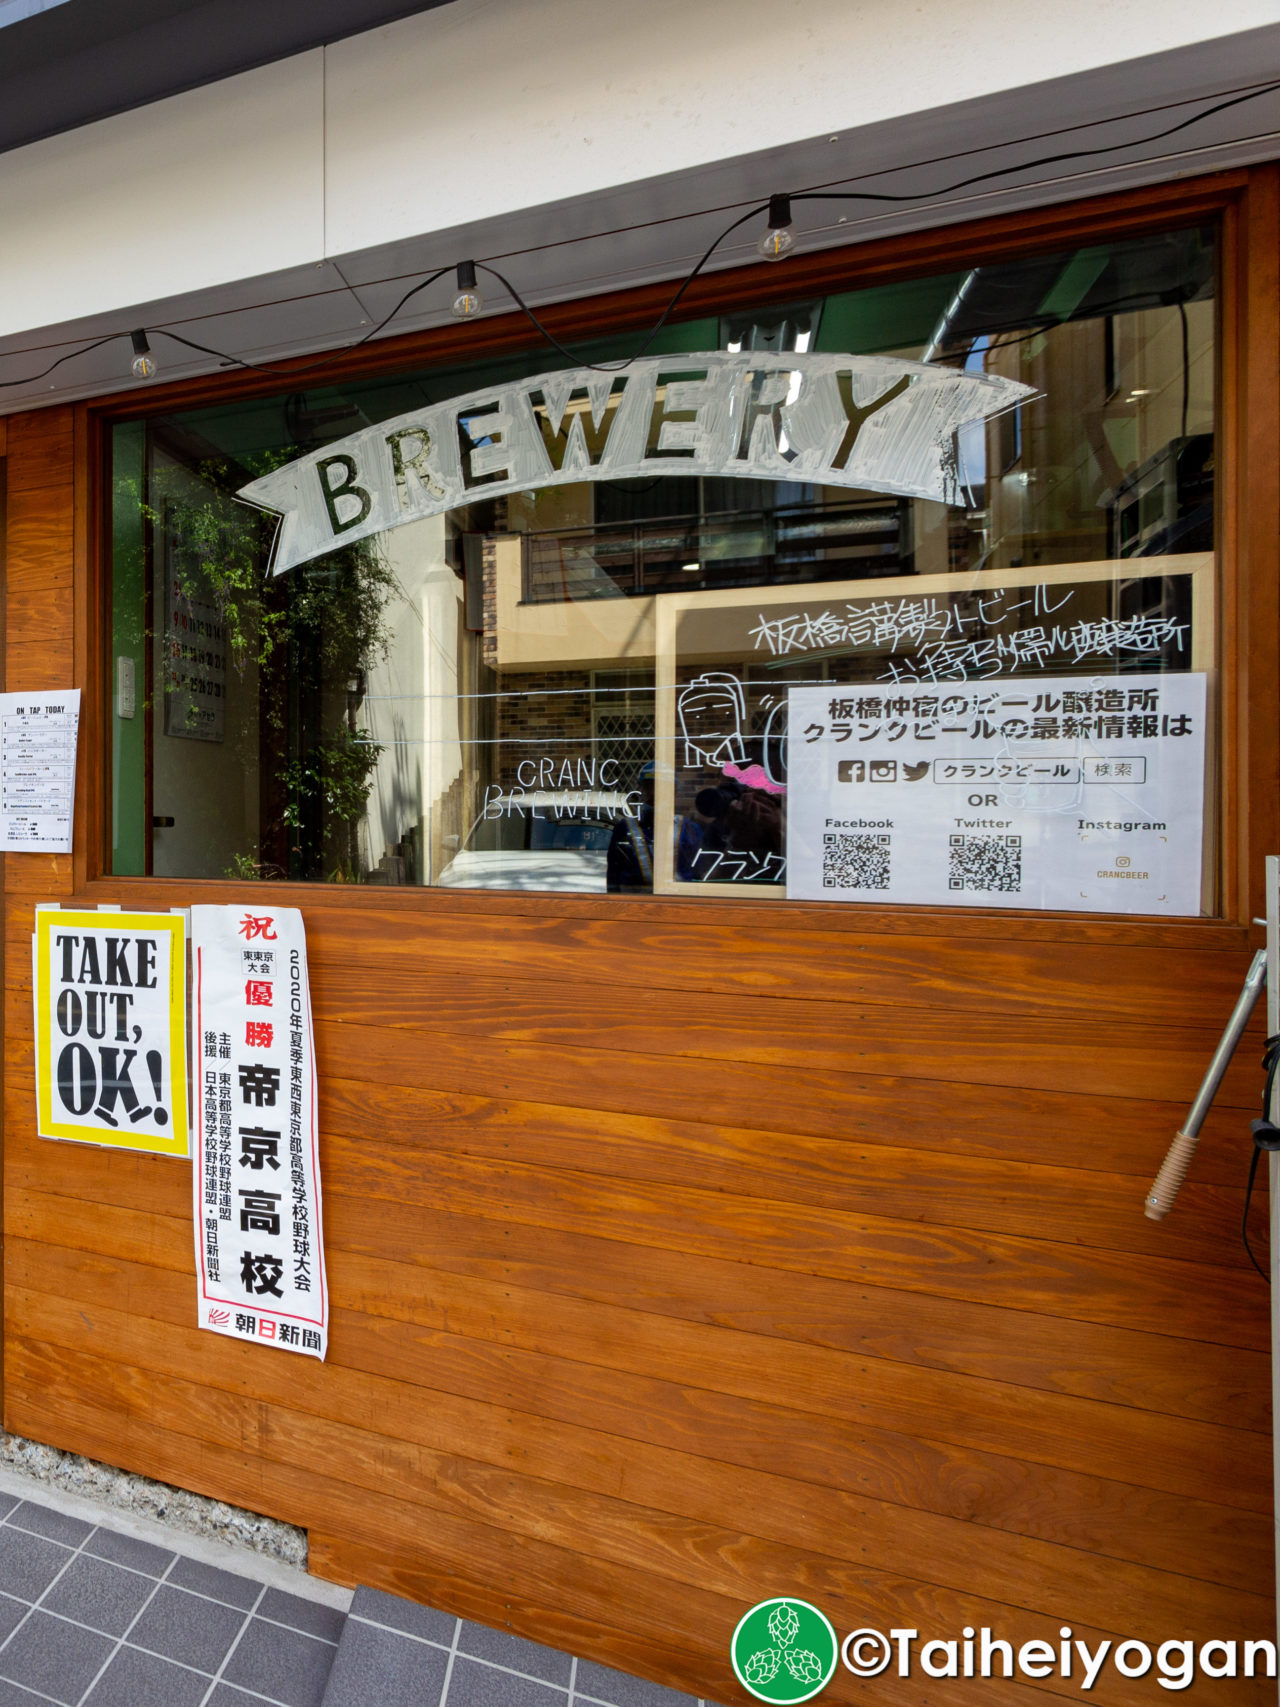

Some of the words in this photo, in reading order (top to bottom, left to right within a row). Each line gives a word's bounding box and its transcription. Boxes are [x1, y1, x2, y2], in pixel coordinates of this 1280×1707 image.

[316, 368, 911, 536] BREWERY
[16, 706, 25, 715] ON
[29, 706, 41, 715] TAP
[45, 705, 65, 714] TODAY
[828, 688, 1160, 720] 板橋仲宿のビール醸造所
[802, 714, 1193, 743] クランクビールの最新情報は
[517, 757, 619, 788] CRANC
[943, 763, 1071, 778] クランクビール
[1094, 763, 1133, 777] 検索
[483, 784, 644, 821] BREWING
[967, 794, 999, 807] OR
[825, 817, 894, 829] Facebook
[954, 817, 1013, 829] Twitter
[1077, 818, 1167, 832] Instagram
[691, 848, 787, 881] クランク
[1096, 870, 1149, 880] CRANCBEER
[238, 913, 278, 941] 祝
[56, 935, 158, 988] TAKE
[243, 951, 274, 962] 東東京
[247, 963, 271, 974] 大会
[56, 988, 143, 1044] OUT,
[244, 979, 274, 1049] 優勝
[56, 1042, 169, 1127] OK!
[238, 1063, 284, 1299] 帝京高校
[235, 1313, 321, 1352] 朝日新聞
